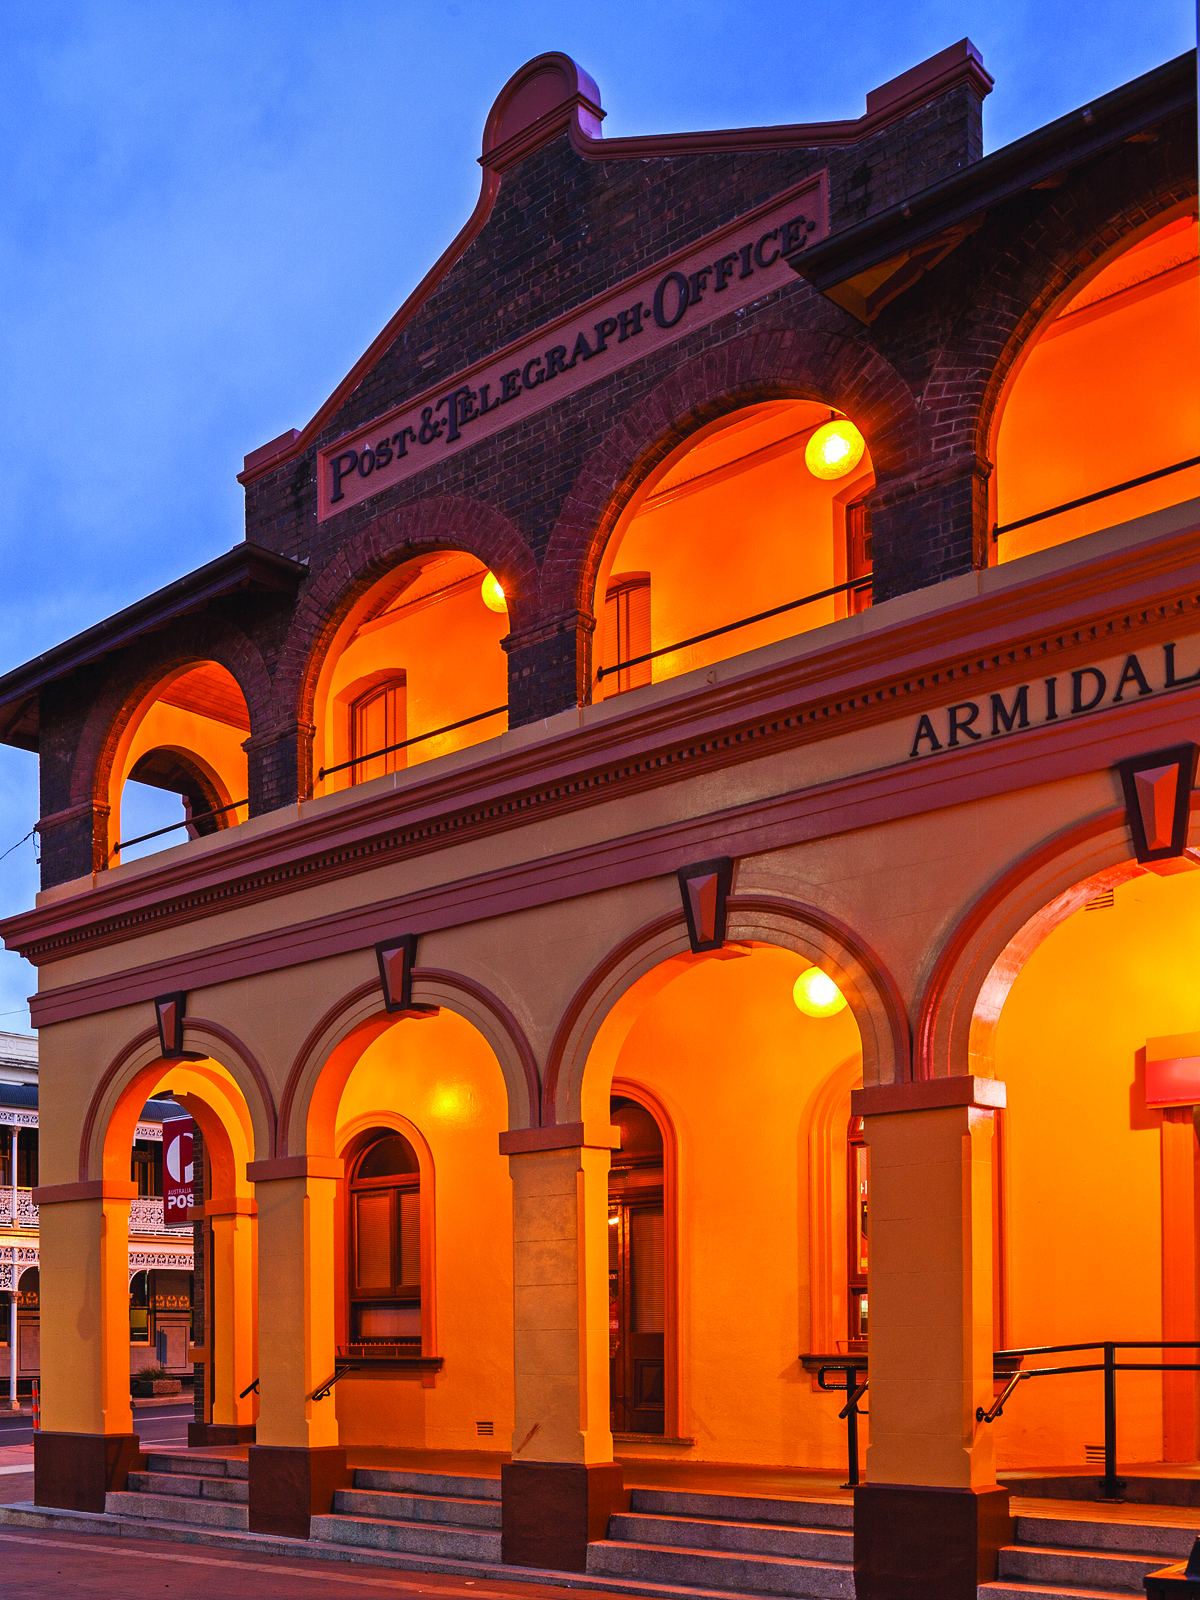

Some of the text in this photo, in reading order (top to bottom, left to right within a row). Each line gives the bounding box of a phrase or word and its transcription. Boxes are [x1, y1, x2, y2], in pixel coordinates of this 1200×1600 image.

[437, 299, 644, 443] TELEGRAPH
[909, 642, 1200, 757] ARMIDAL
[168, 1187, 191, 1195] AUSTRALIA
[168, 1193, 194, 1209] POS
